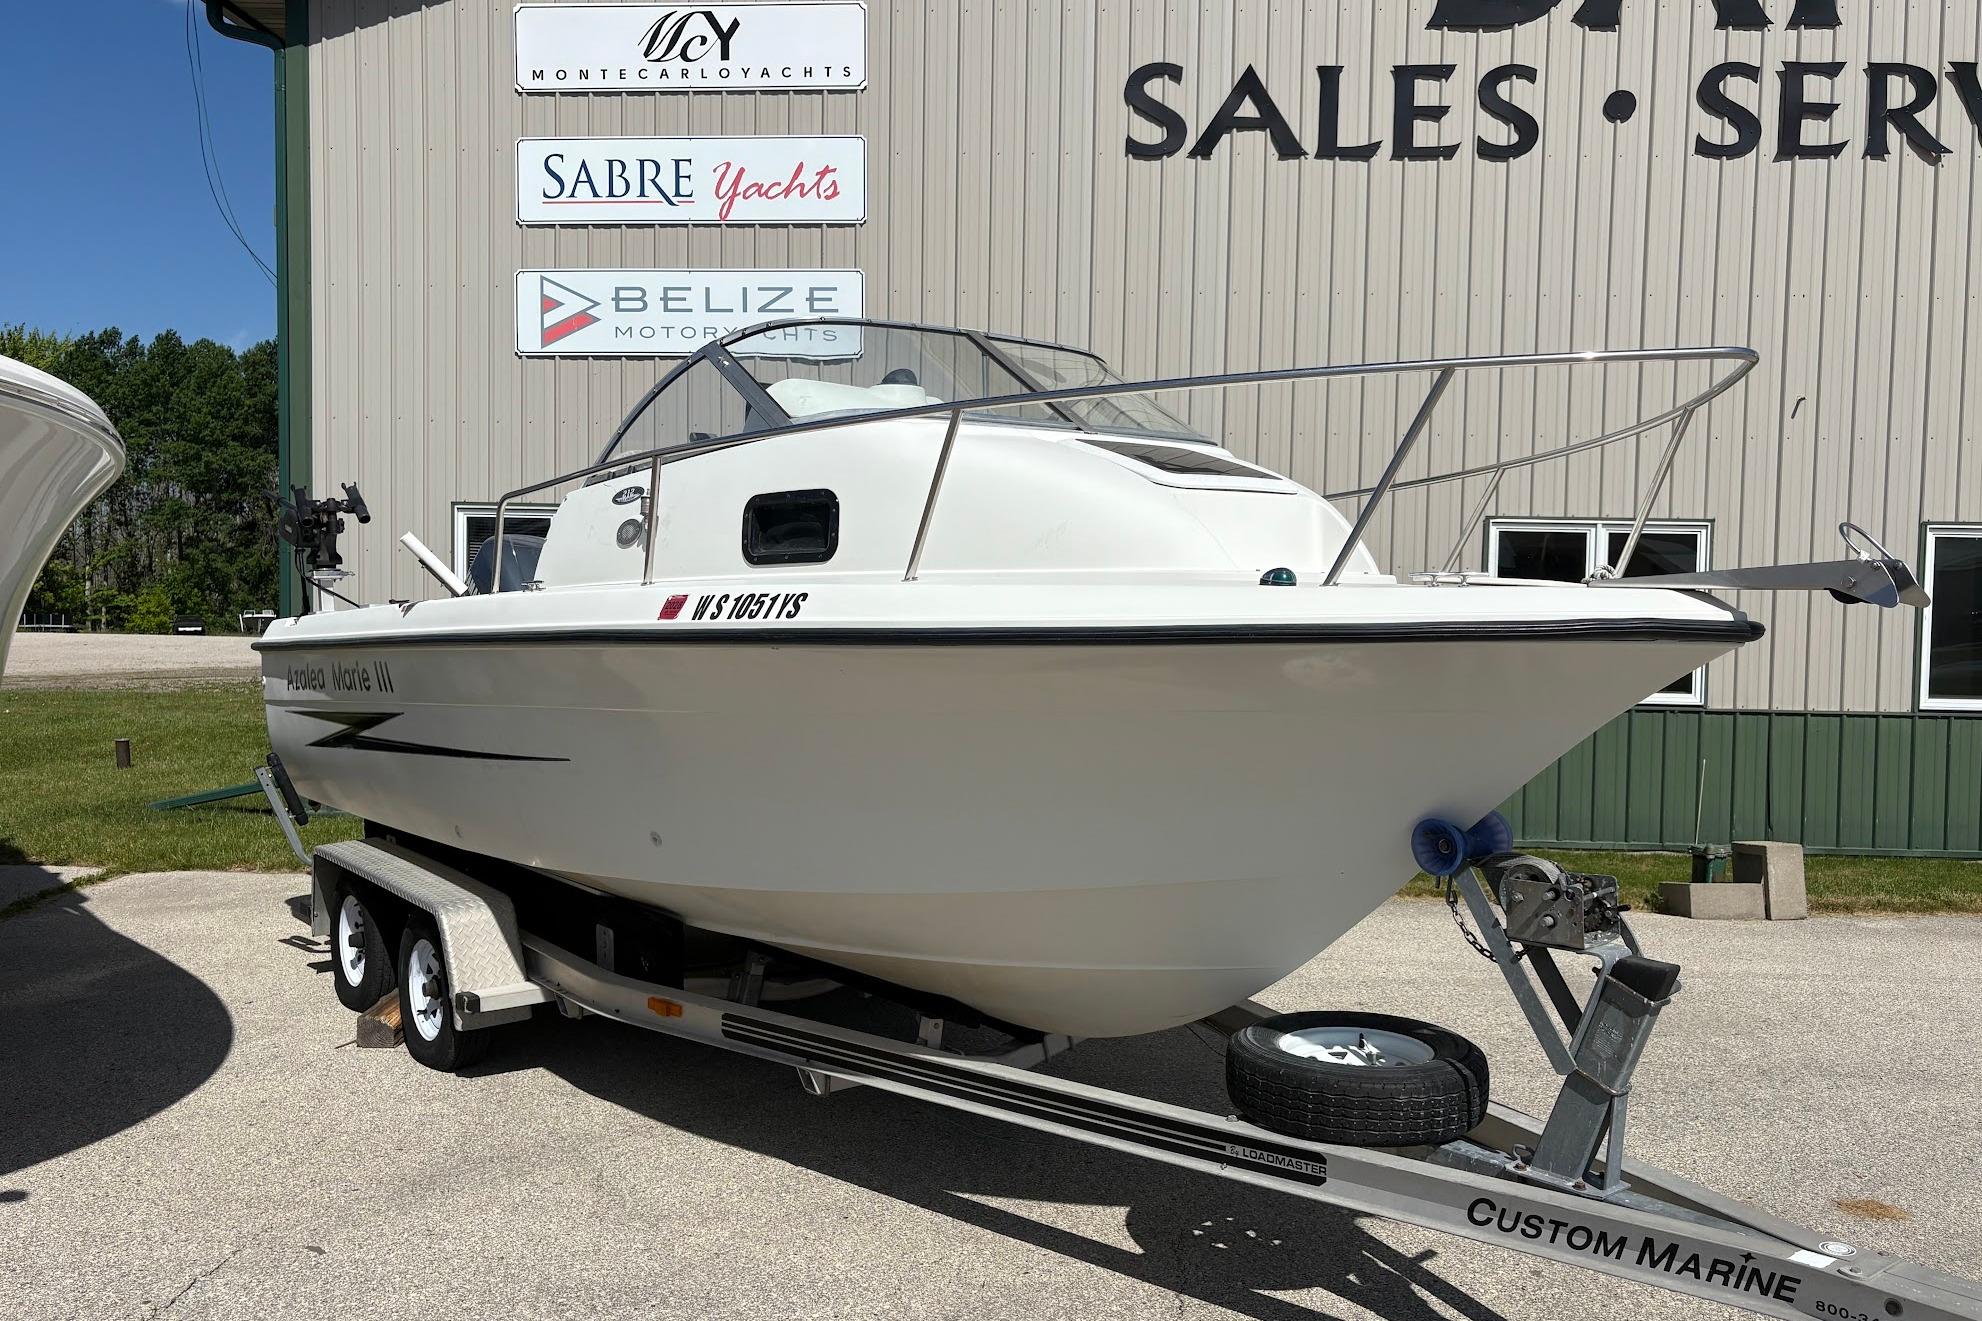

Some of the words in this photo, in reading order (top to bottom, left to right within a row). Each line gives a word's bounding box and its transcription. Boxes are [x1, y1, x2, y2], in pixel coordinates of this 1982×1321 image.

[532, 66, 851, 81] MONTECARLOYACHTS
[1124, 62, 1539, 160] SALES
[542, 153, 694, 206] SABRE
[712, 161, 840, 222] Yachts
[611, 286, 839, 313] BELIZE
[615, 326, 838, 342] MOTORYCHTS
[287, 663, 325, 691] Azalea
[331, 660, 371, 692] Marie
[1242, 1147, 1327, 1176] LOADMASTER
[1815, 1300, 1880, 1321] 800-3
